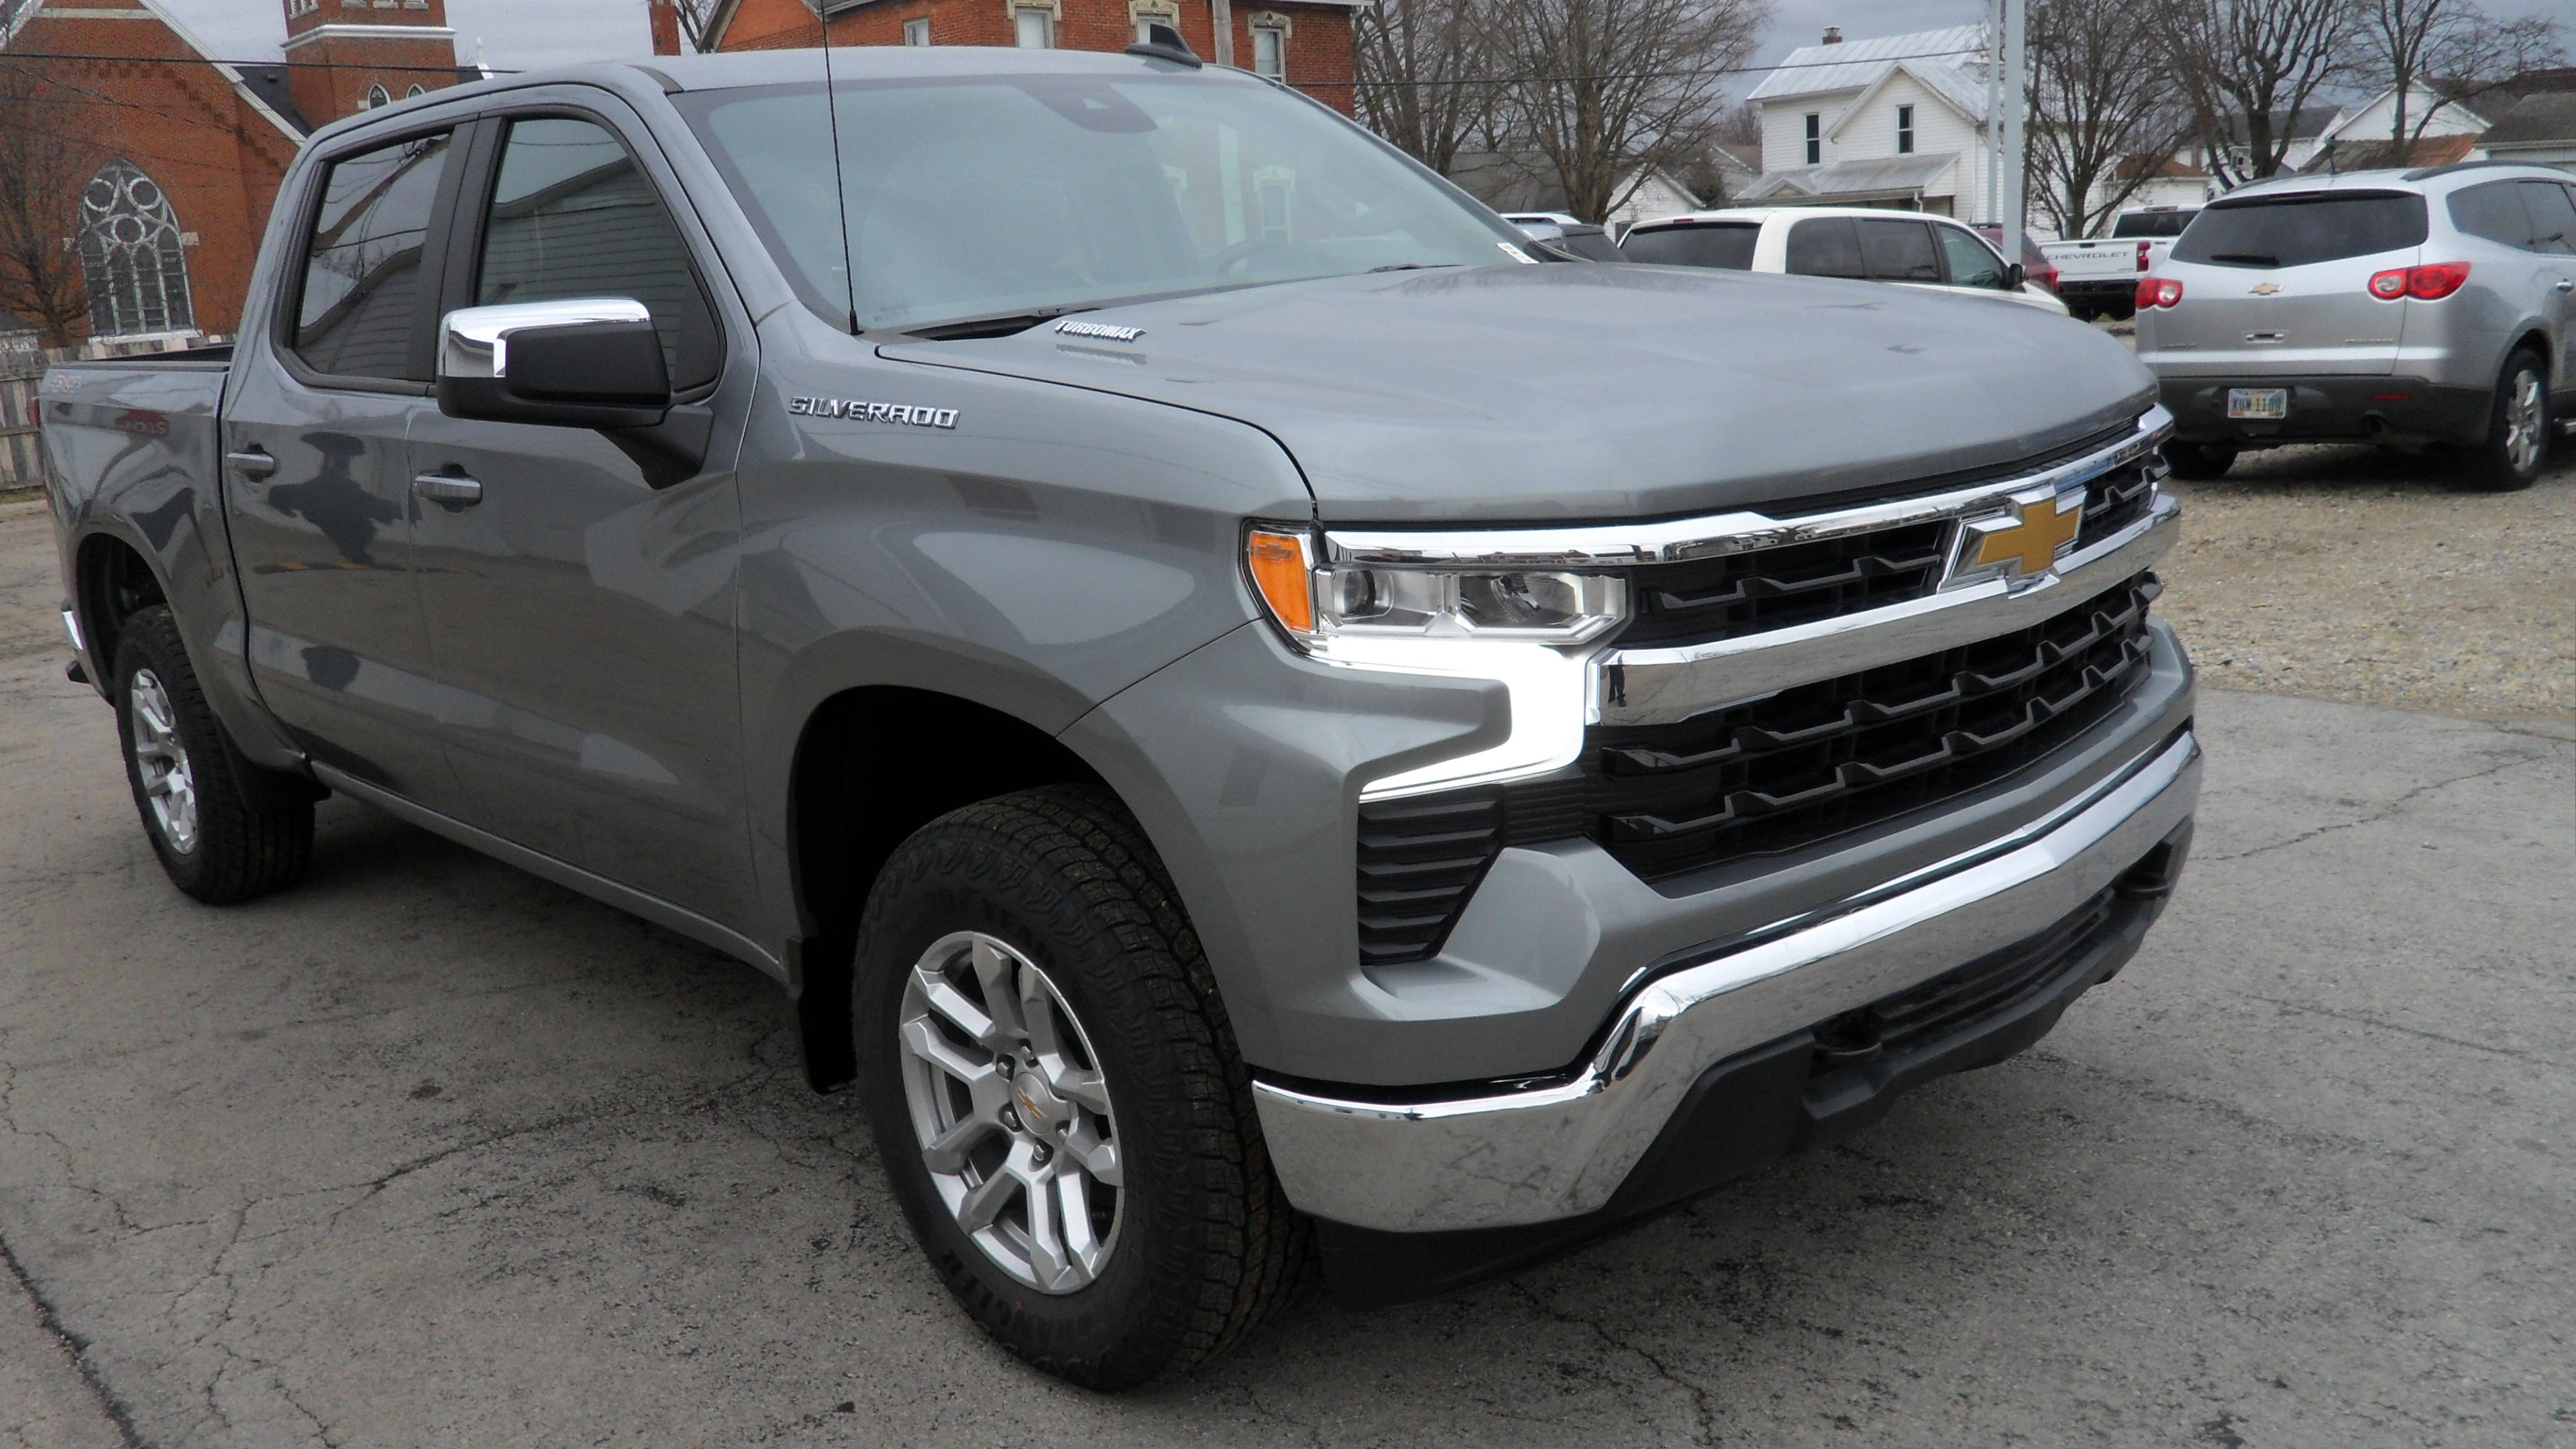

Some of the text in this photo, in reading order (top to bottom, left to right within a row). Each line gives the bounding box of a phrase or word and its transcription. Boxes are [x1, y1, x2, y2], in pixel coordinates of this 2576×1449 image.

[2046, 251, 2129, 260] CHEVROLET
[1055, 320, 1147, 341] TURBOMAX
[788, 396, 961, 430] SILVERADO
